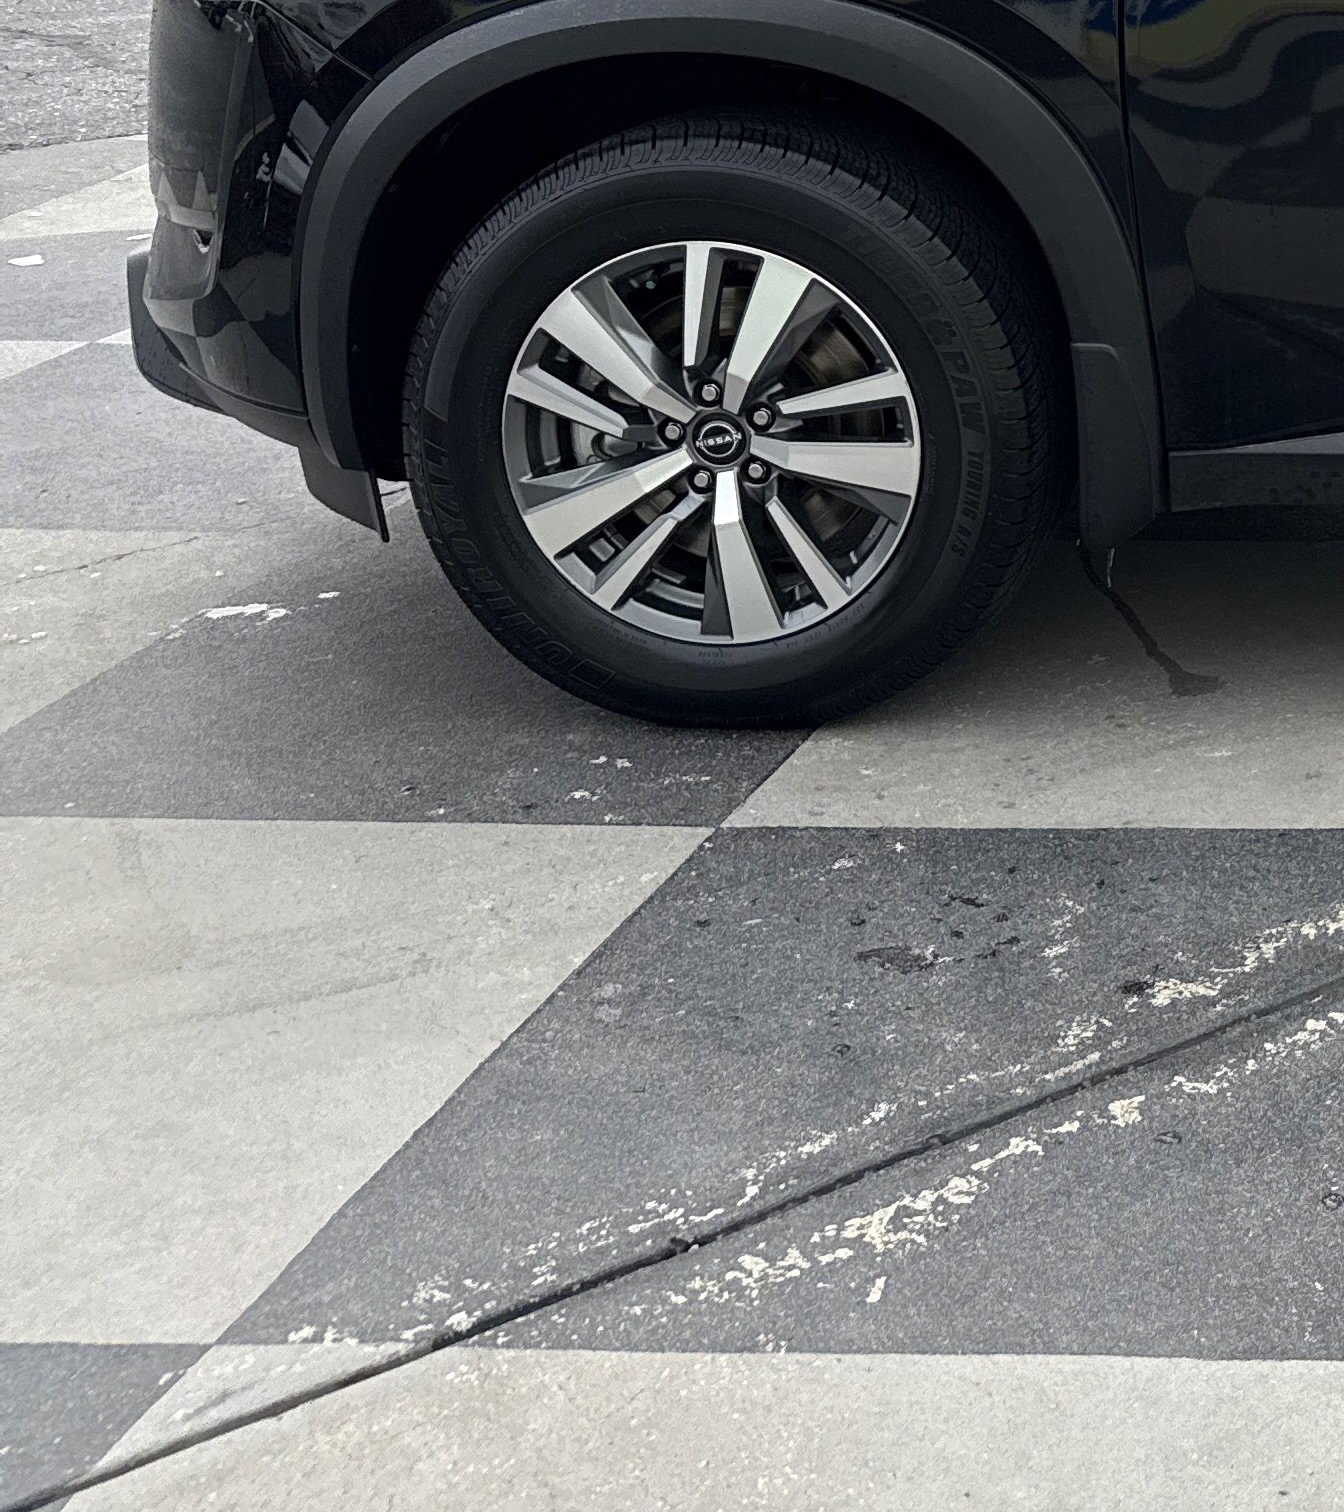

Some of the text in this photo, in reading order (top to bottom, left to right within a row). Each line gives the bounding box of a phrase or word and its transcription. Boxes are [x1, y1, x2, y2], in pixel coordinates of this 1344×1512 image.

[939, 344, 986, 434] PAW
[695, 432, 742, 448] NISSAN
[959, 449, 983, 519] TOURING
[422, 434, 576, 678] UNIROYAL
